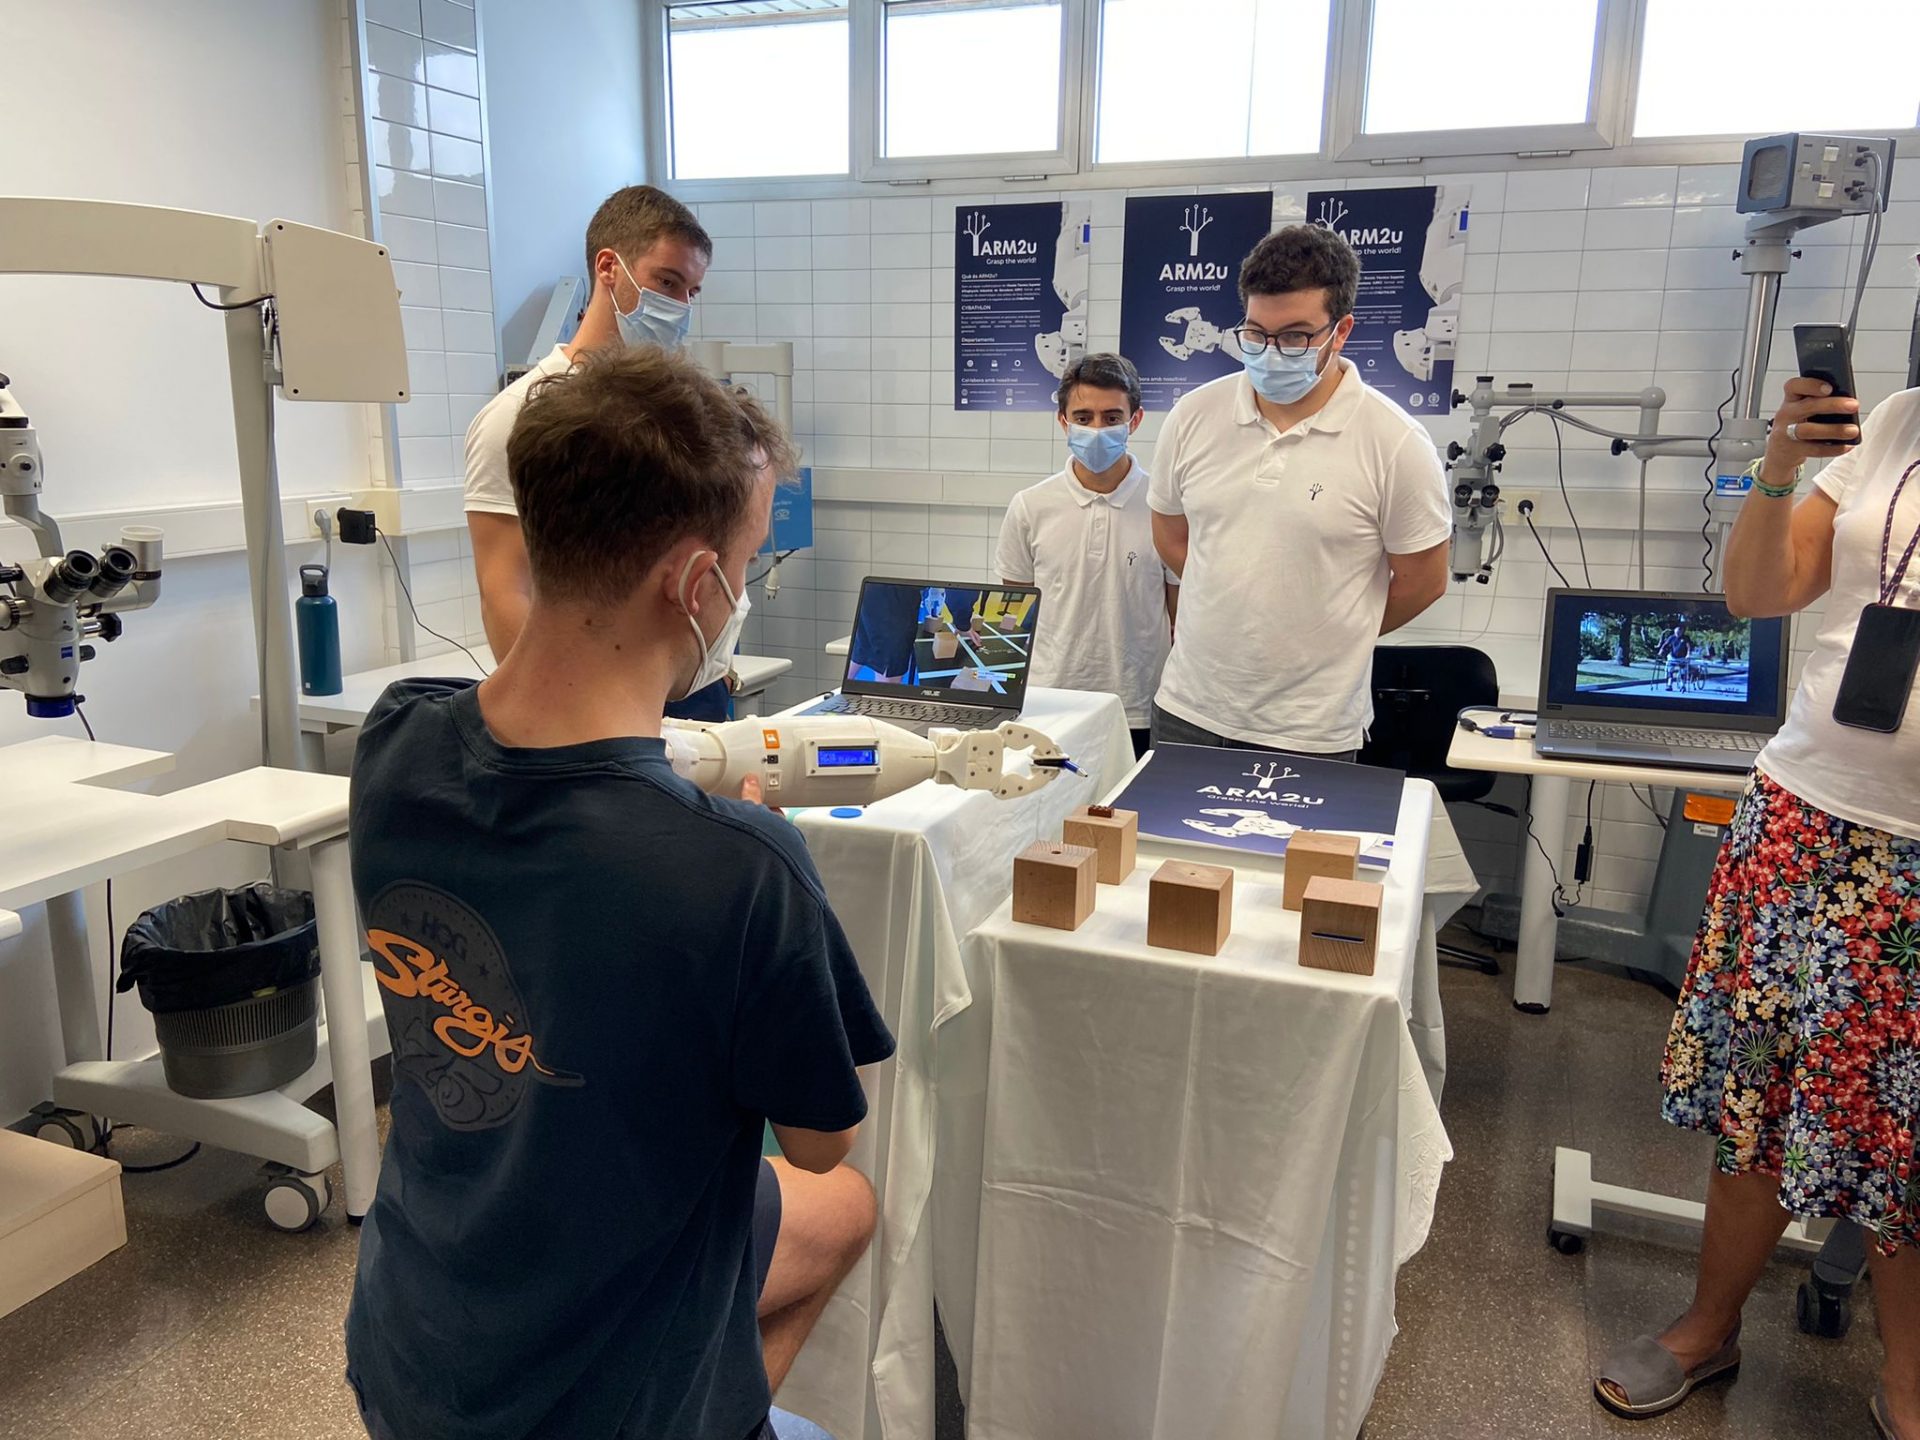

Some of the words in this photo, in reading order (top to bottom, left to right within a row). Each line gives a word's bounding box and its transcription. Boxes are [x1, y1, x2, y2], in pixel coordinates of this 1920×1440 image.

[980, 239, 1037, 256] ARM2u
[1159, 262, 1229, 281] ARM2u
[1165, 285, 1185, 293] Grasp
[1206, 794, 1243, 802] Grasp
[1270, 801, 1309, 809] world!
[368, 929, 556, 1075] Sturgis
